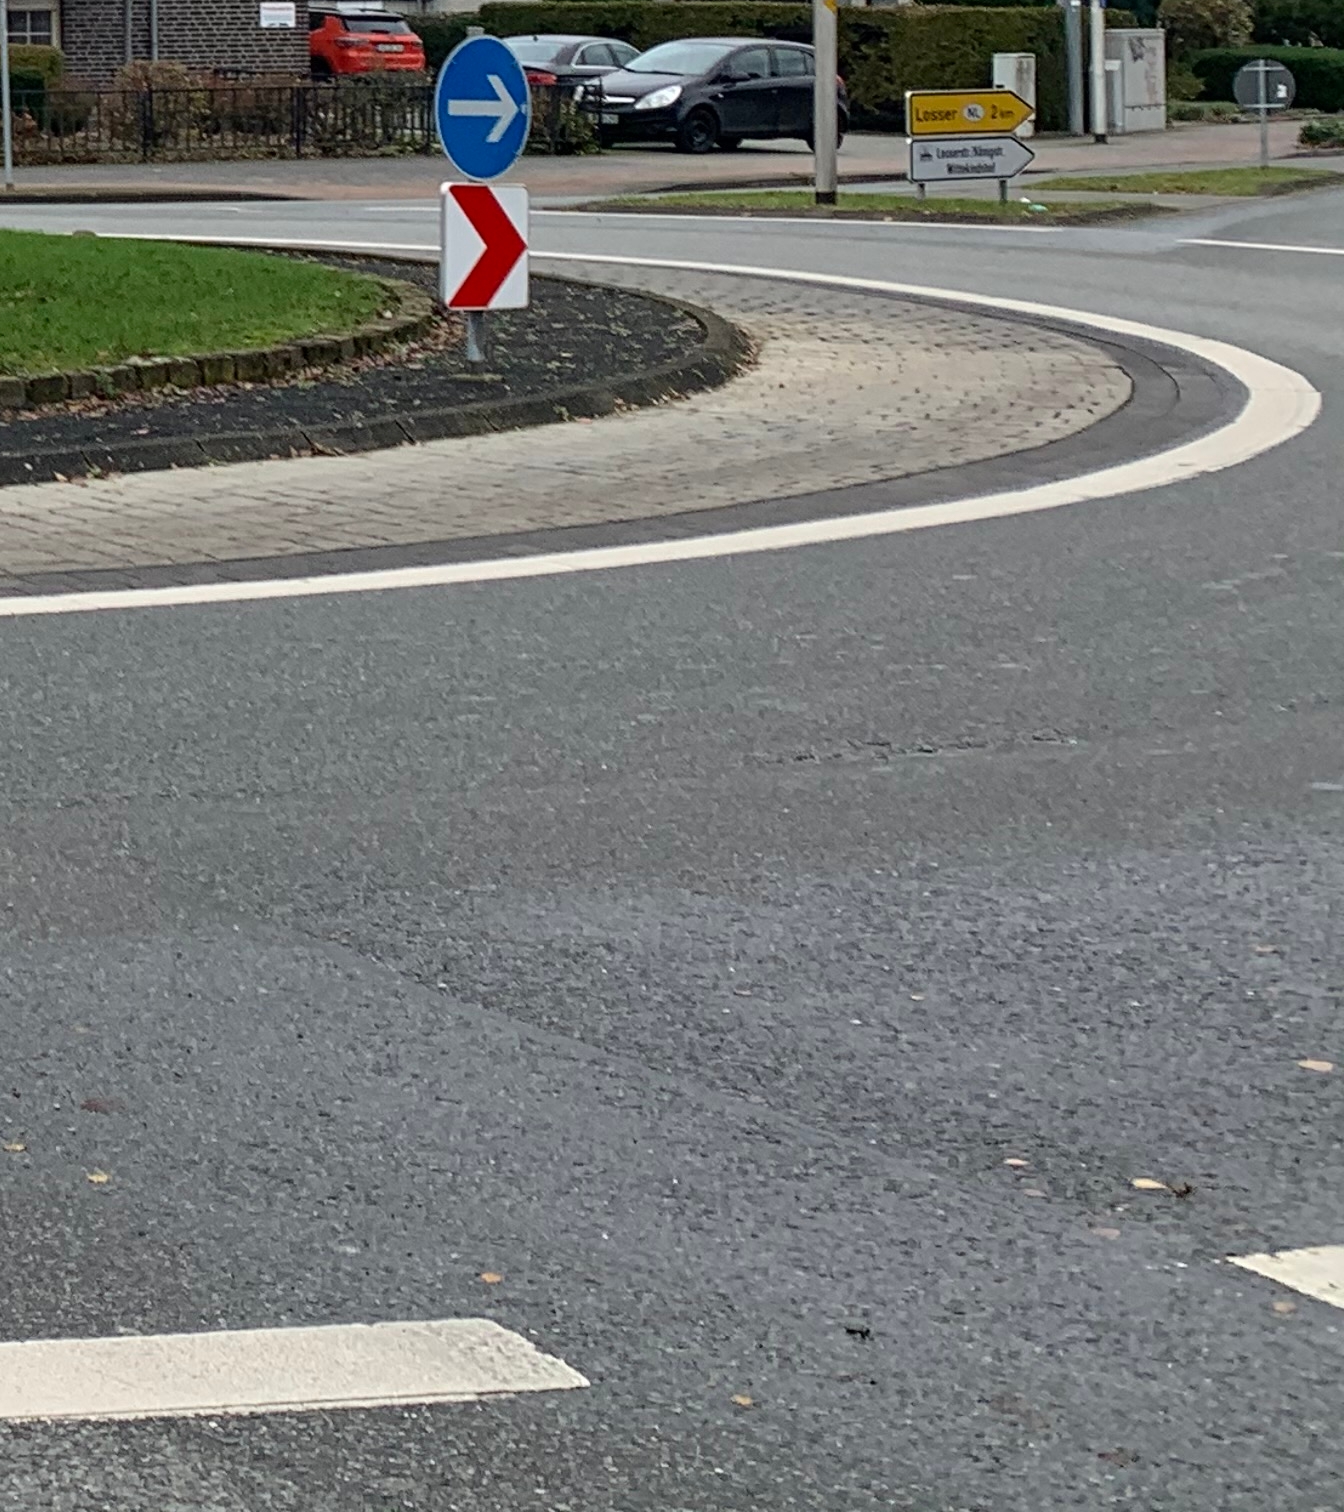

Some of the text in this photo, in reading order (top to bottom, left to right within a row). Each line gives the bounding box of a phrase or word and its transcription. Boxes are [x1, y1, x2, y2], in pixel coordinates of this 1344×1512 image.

[915, 107, 958, 123] Losser
[967, 107, 981, 119] NL
[990, 104, 998, 119] 2
